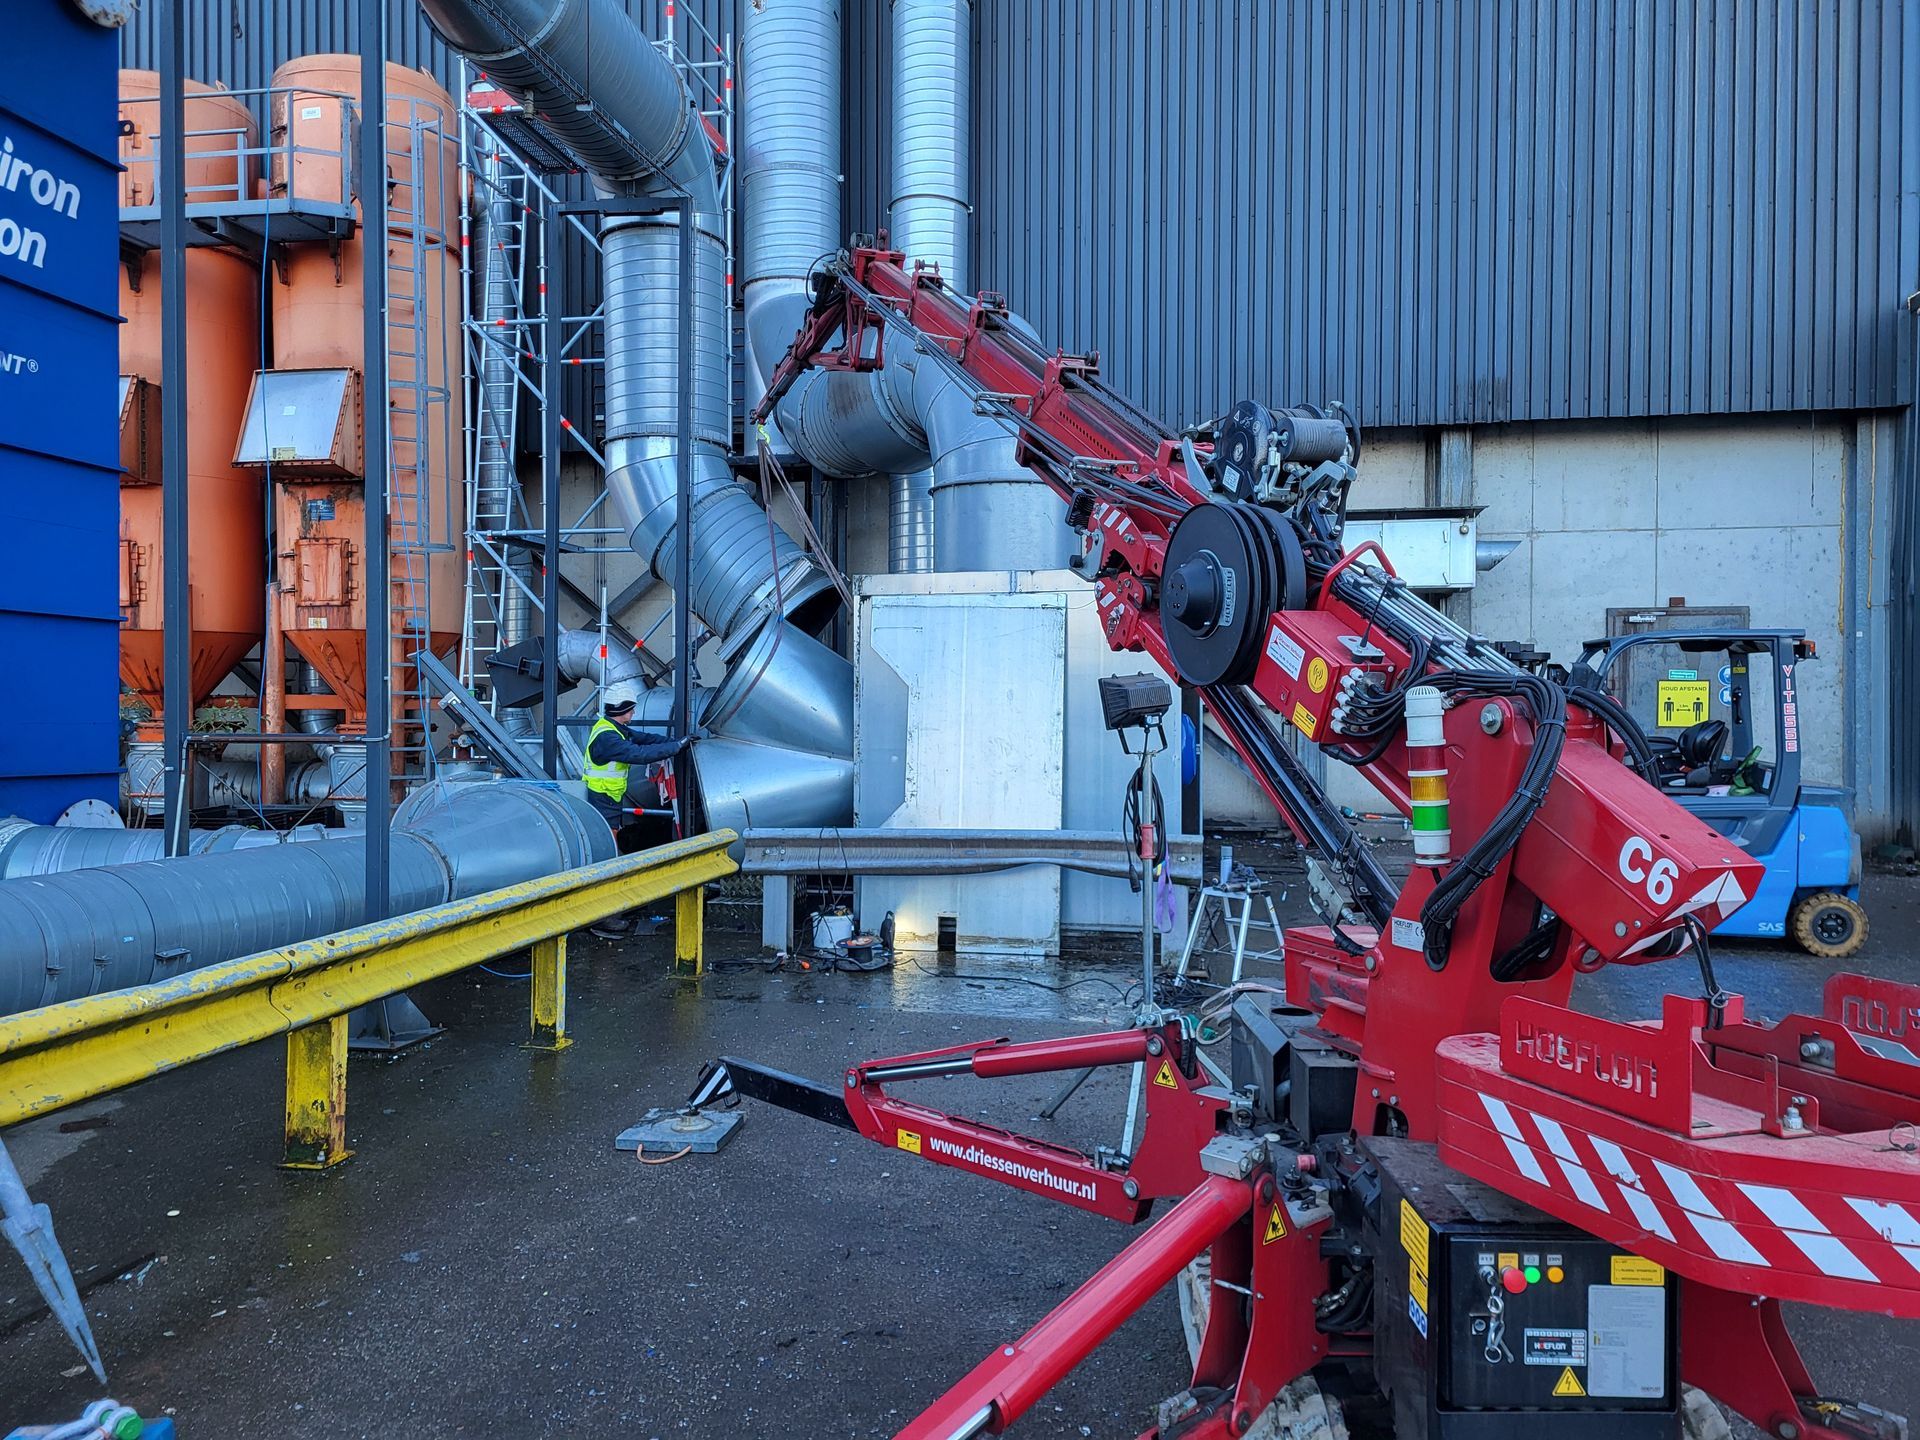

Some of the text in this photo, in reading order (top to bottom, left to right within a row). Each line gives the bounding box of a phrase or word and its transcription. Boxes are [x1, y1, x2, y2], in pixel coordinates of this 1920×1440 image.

[0, 136, 81, 219] iron
[0, 218, 47, 269] on
[1782, 665, 1798, 752] VITESSE
[1619, 836, 1679, 905] C6
[1758, 922, 1784, 932] SAS
[1515, 1020, 1657, 1099] HOEFLON
[929, 1136, 1097, 1201] www.driessenverhuur.nl
